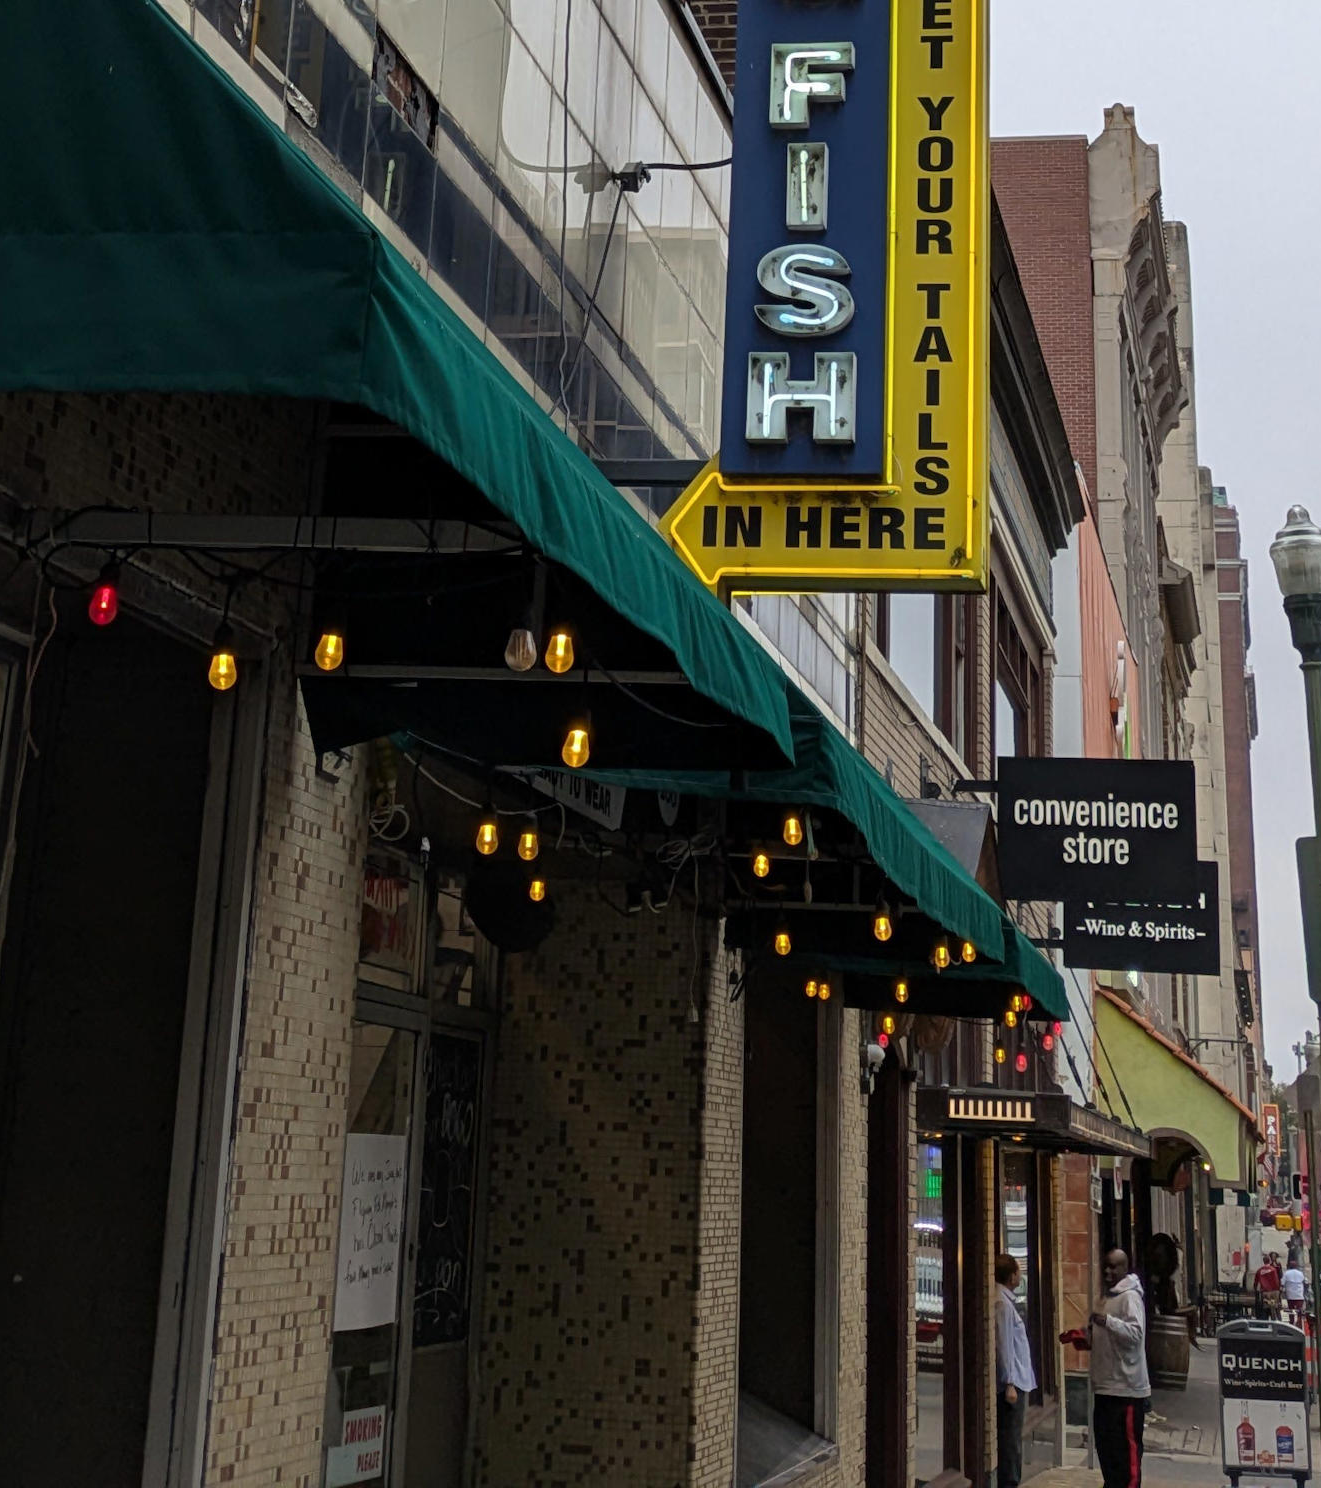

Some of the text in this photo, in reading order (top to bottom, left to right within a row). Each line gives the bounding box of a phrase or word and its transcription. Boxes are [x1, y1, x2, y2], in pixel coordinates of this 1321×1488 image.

[915, 96, 956, 256] YOUR
[745, 42, 856, 445] FISH
[912, 282, 955, 497] TAILS
[701, 505, 946, 550] IN HERE
[1014, 793, 1178, 829] convenience
[1063, 832, 1129, 865] store
[1129, 921, 1143, 937] &
[1266, 1115, 1277, 1154] PARK
[1222, 1353, 1302, 1371] QUENCH
[344, 1414, 382, 1445] SMOKING
[356, 1450, 380, 1473] PLEASE
